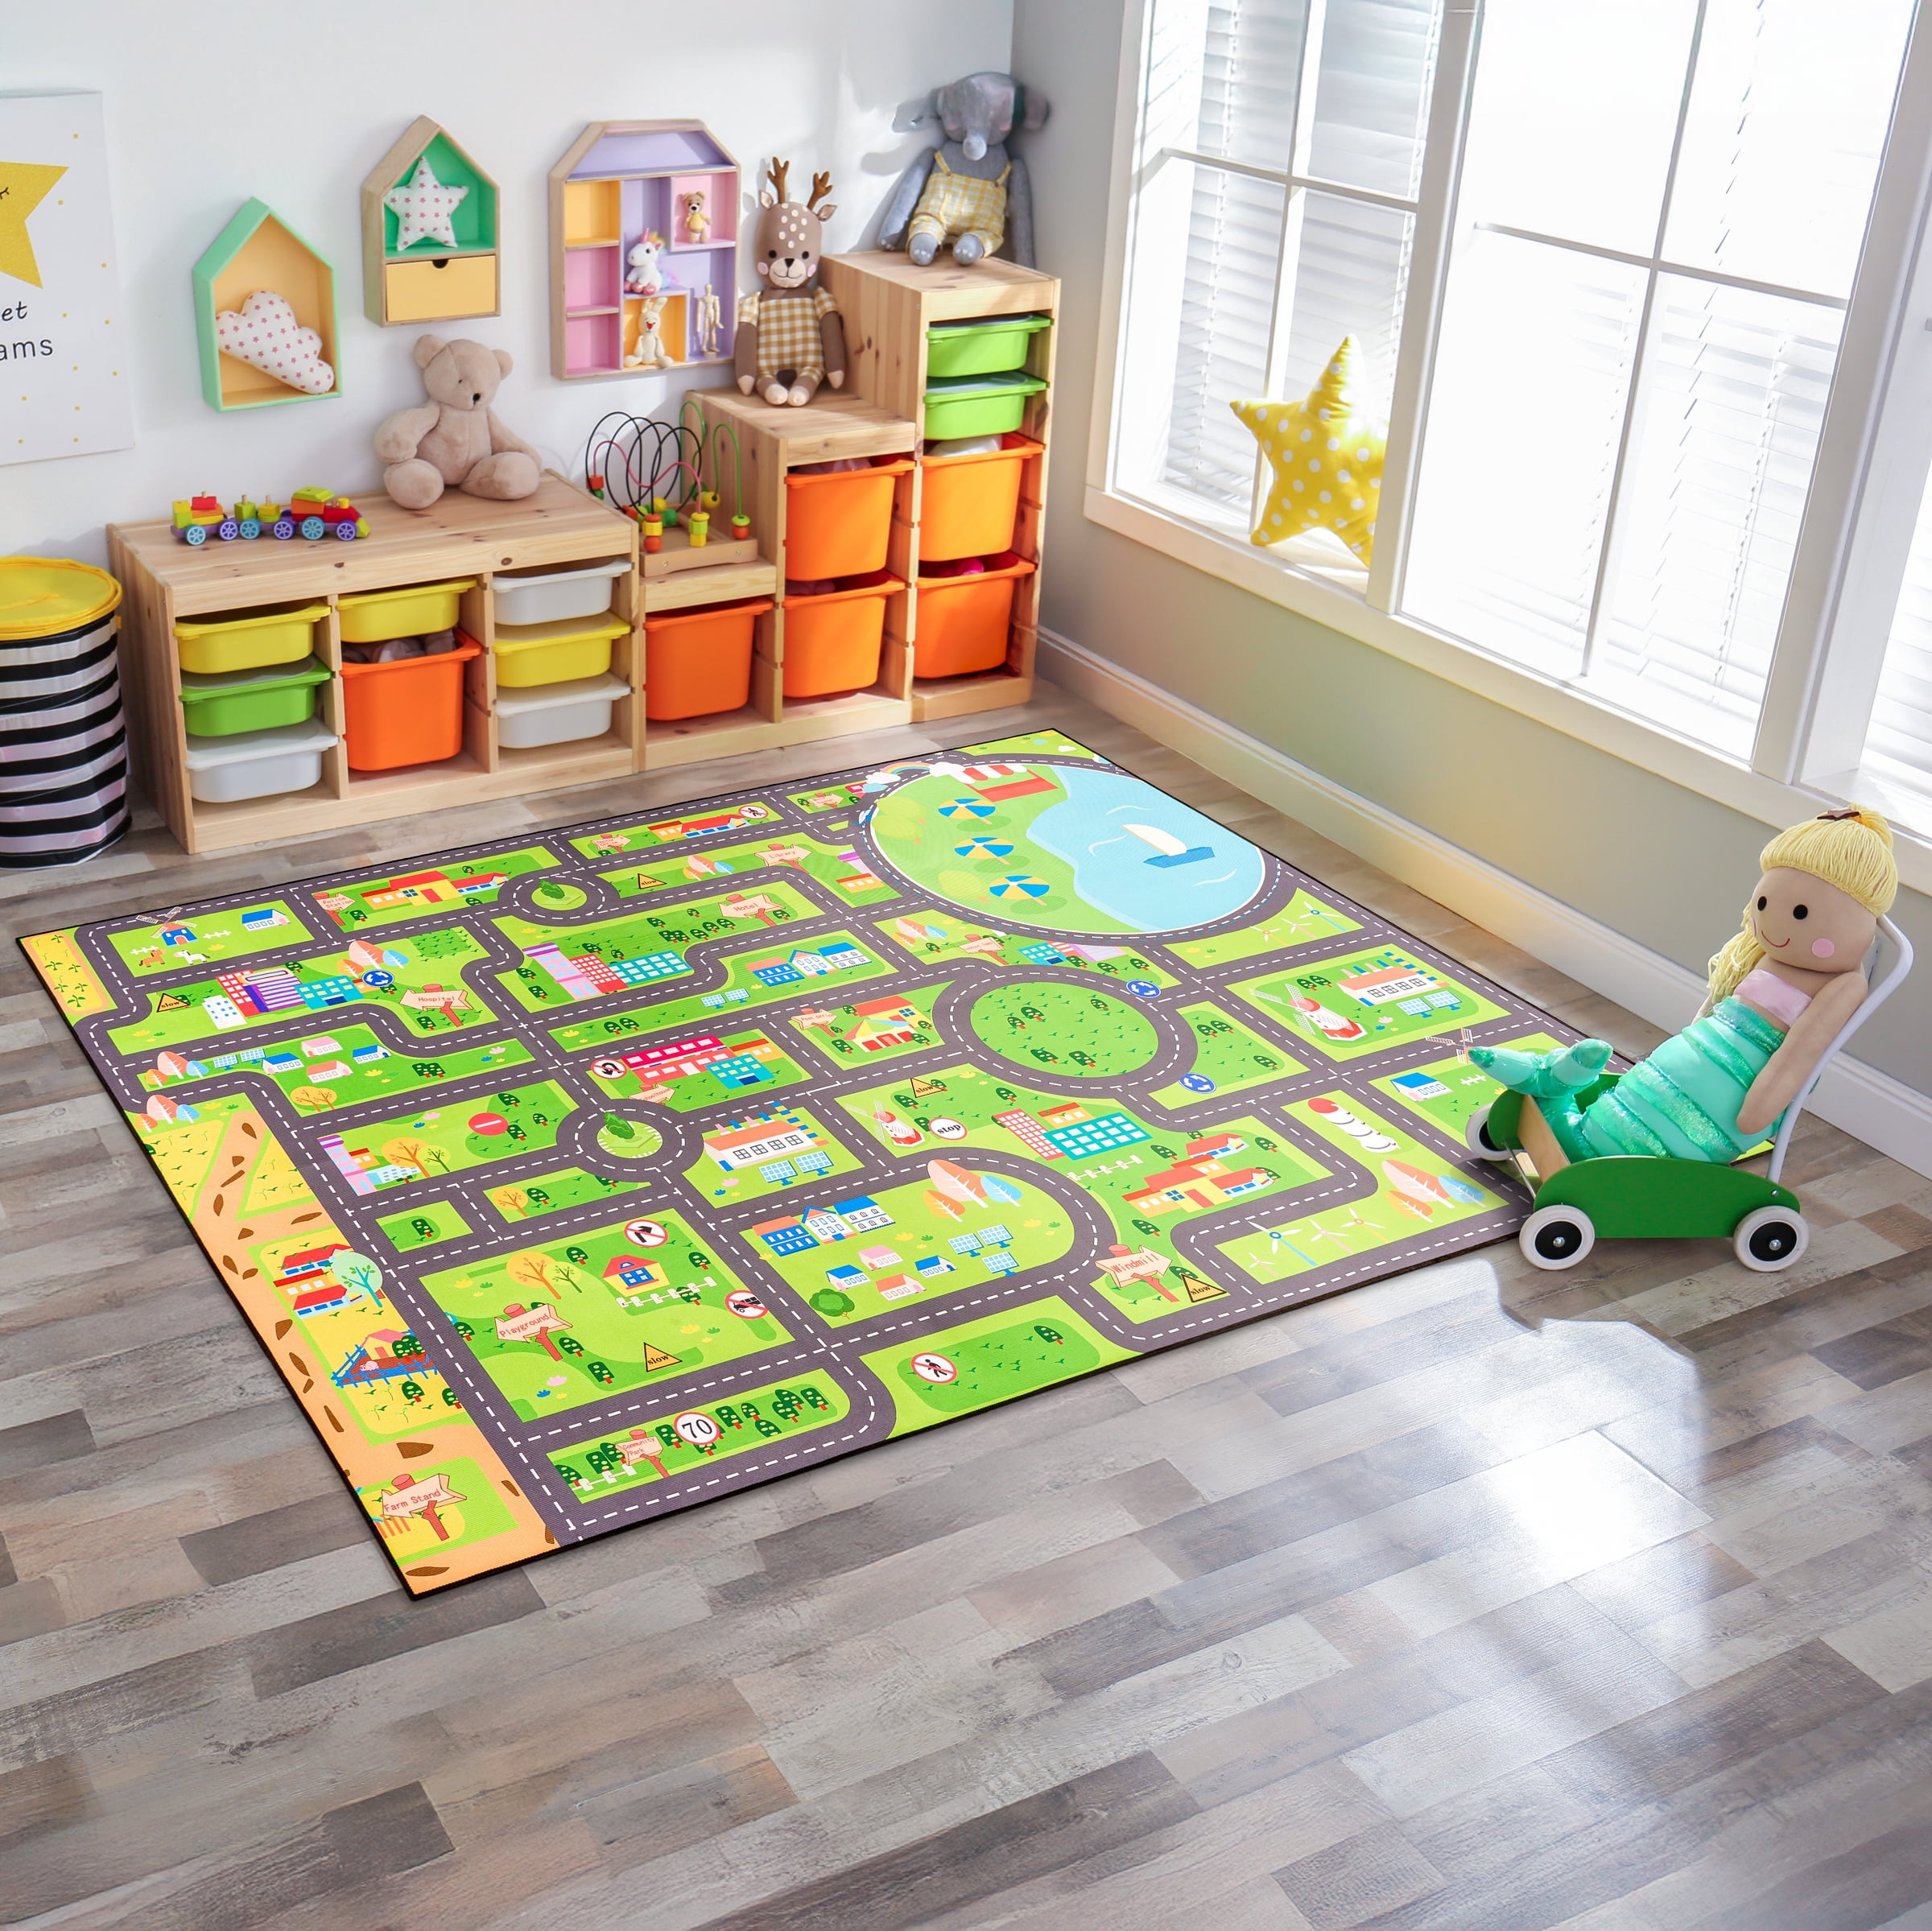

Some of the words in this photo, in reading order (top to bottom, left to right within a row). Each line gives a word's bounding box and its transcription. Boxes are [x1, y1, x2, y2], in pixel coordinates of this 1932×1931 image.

[325, 900, 353, 909] Station
[733, 902, 759, 911] Hotel
[916, 1085, 934, 1093] slow
[937, 1124, 961, 1134] stop
[1110, 1253, 1159, 1273] Windmill
[1191, 1285, 1212, 1295] slow
[499, 1313, 550, 1337] Playground
[647, 1355, 669, 1365] slow
[682, 1419, 712, 1438] 70
[622, 1437, 655, 1449] Community
[383, 1500, 408, 1512] Farm
[411, 1488, 441, 1504] Stand
